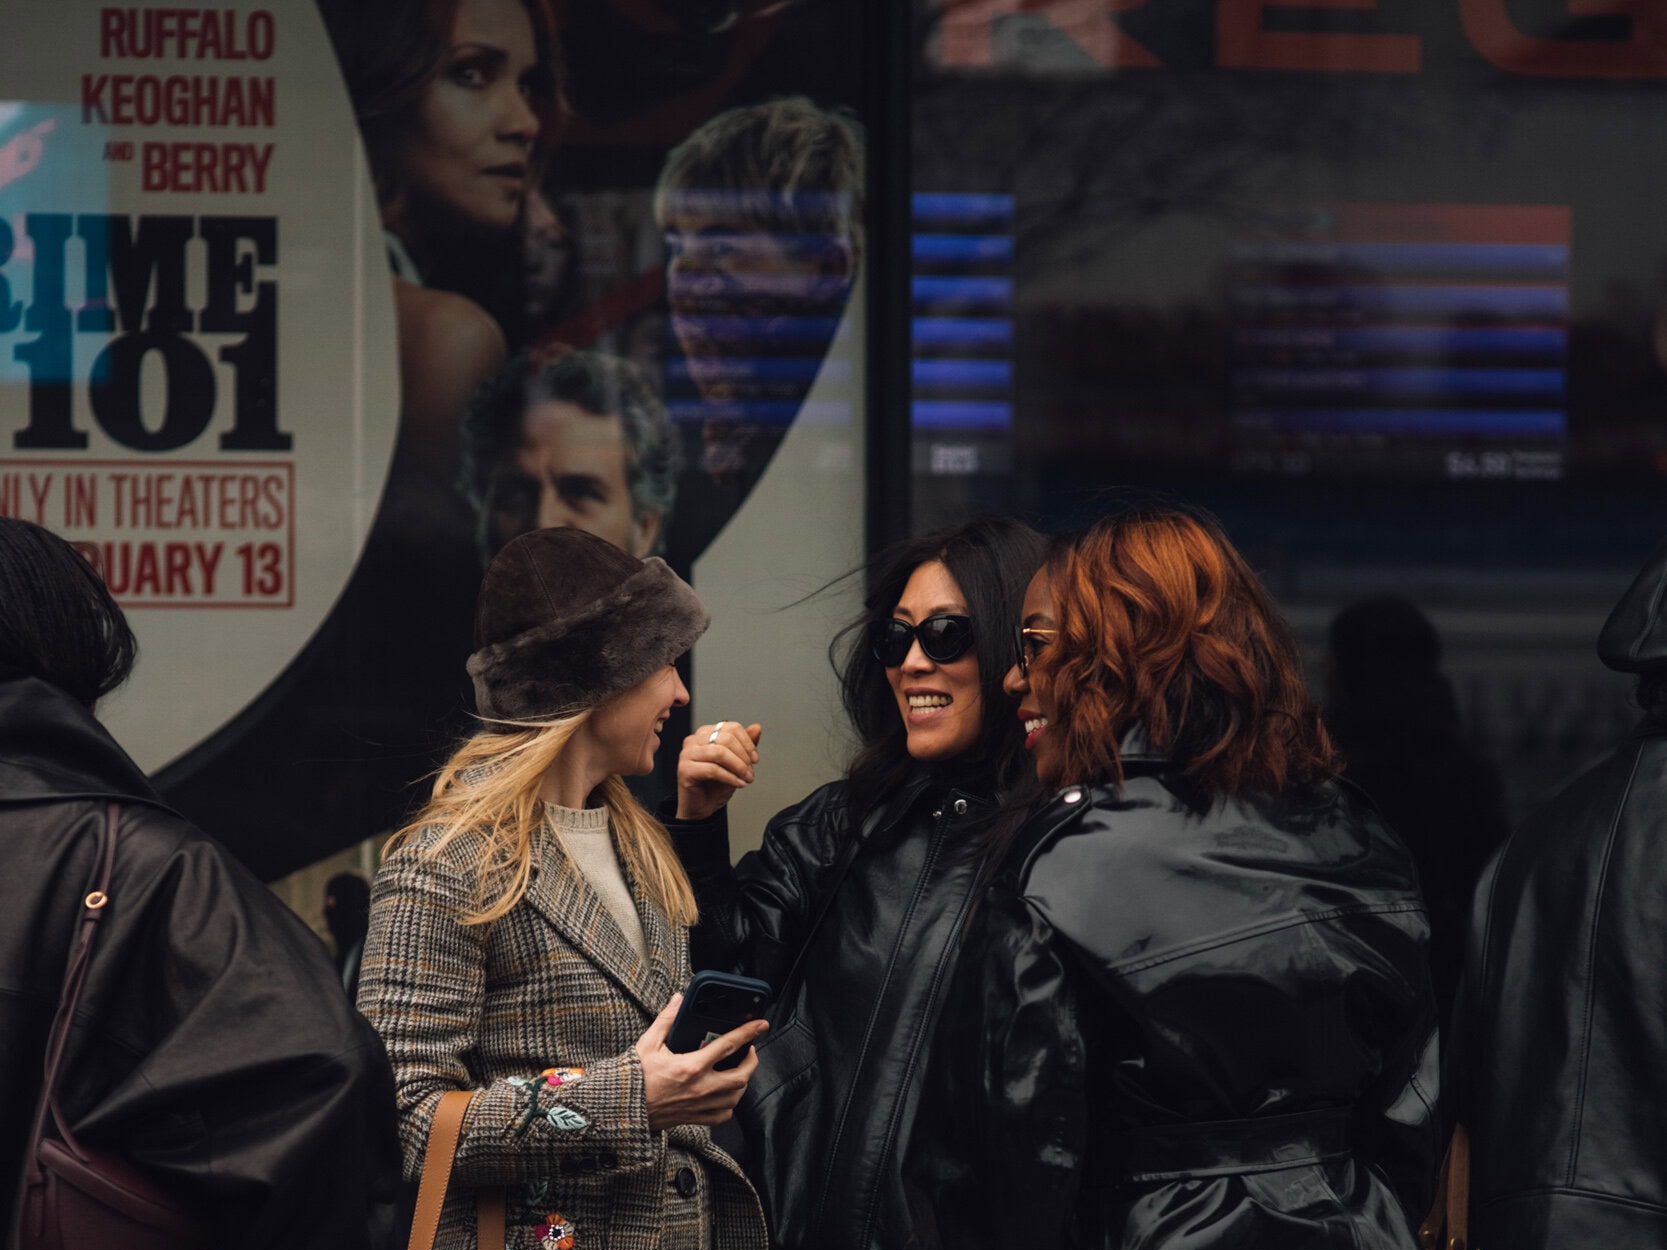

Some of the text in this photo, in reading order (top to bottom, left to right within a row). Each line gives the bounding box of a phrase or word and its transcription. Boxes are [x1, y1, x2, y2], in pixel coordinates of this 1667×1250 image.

[100, 7, 275, 61] RUFFALO
[81, 73, 276, 127] KEOGHAN
[103, 142, 276, 194] AND BERRY
[13, 329, 293, 453] 101
[65, 472, 98, 528] IN
[108, 473, 285, 530] THEATERS
[235, 541, 283, 597] 13
